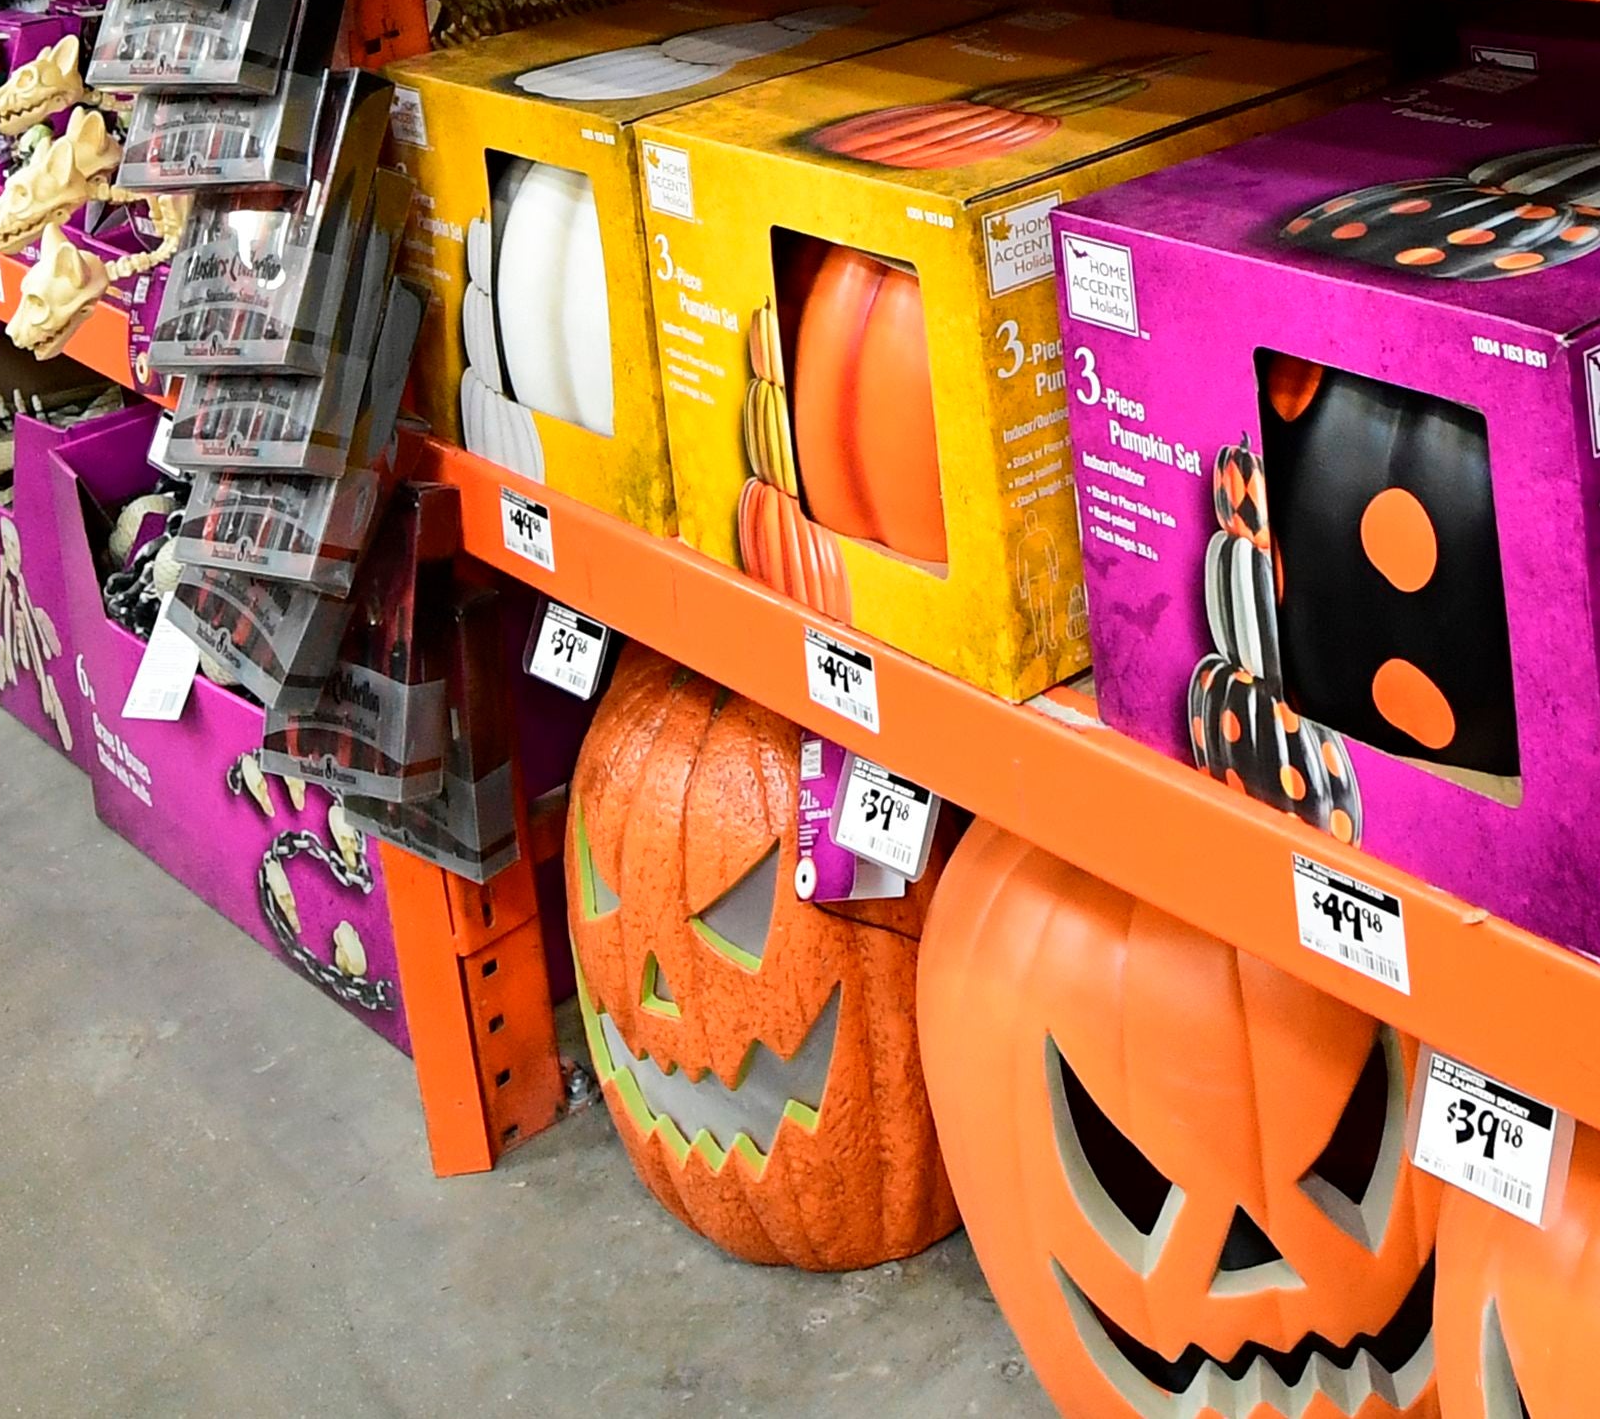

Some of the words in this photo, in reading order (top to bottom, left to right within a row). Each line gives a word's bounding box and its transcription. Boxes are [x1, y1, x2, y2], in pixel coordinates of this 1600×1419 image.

[662, 163, 687, 178] HOME
[651, 177, 689, 196] ACCENTS
[663, 192, 689, 212] Holiday
[994, 234, 1051, 267] ACCENT
[1014, 252, 1054, 277] Holida
[1089, 259, 1127, 282] HOME
[1072, 274, 1130, 302] ACCENTS
[680, 293, 720, 327] Pumpkin
[720, 307, 739, 333] Set
[1089, 296, 1130, 322] Holiday
[1471, 335, 1501, 357] 1004
[1501, 342, 1524, 365] 163
[1524, 348, 1548, 370] 831
[1108, 419, 1173, 467] Pumpkin
[1174, 441, 1203, 477] Set
